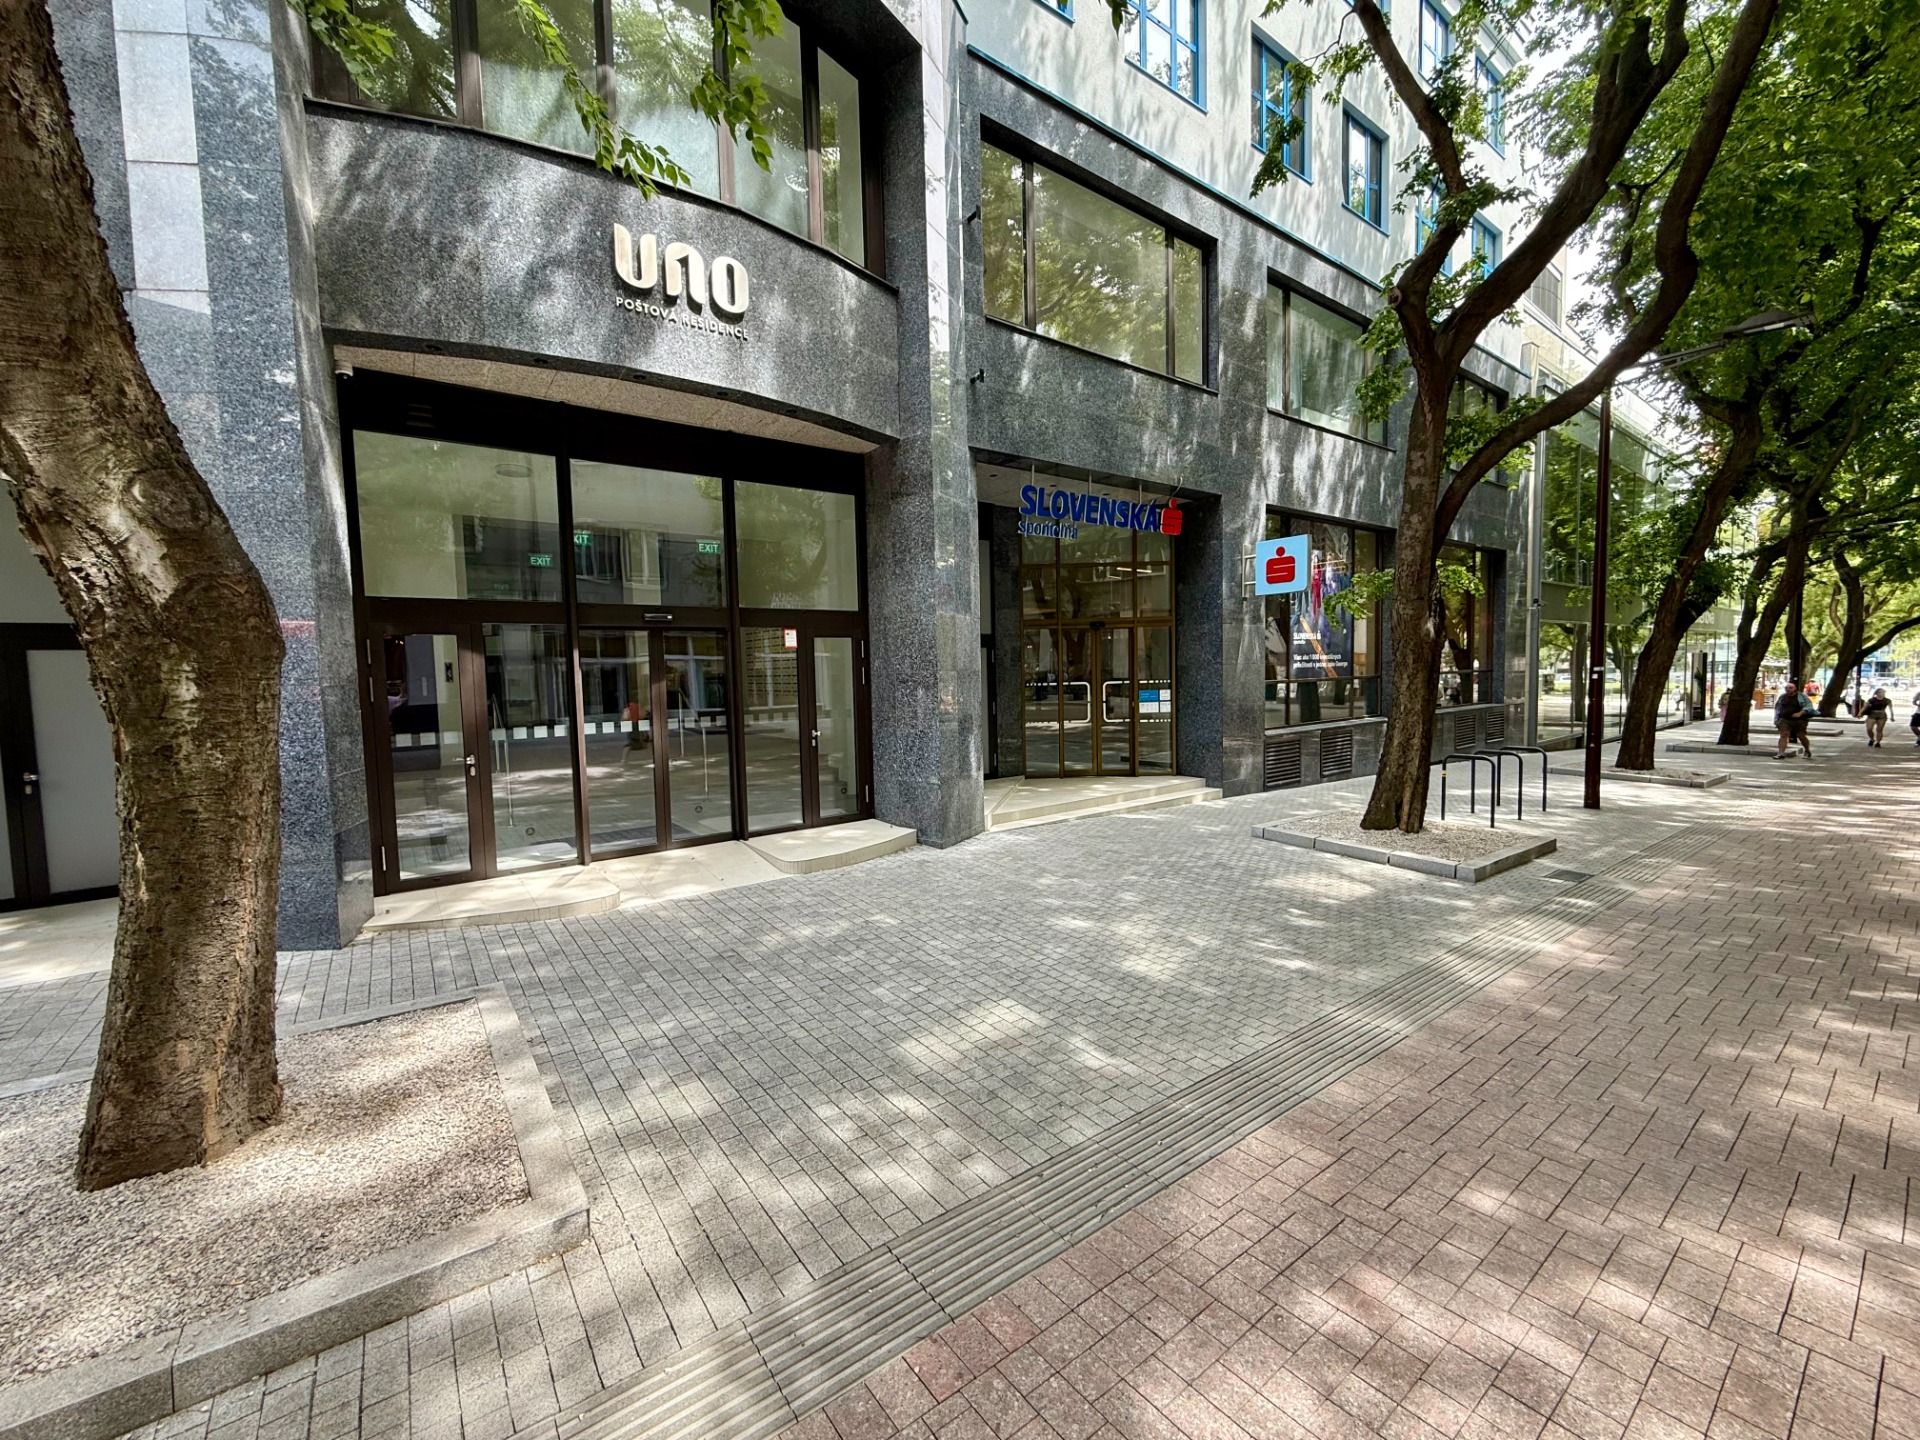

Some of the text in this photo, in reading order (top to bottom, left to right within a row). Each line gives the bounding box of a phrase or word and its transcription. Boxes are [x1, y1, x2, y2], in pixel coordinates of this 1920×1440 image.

[682, 314, 749, 340] RESIDENCE
[1019, 484, 1160, 533] SLOVENSKÁ
[574, 534, 589, 544] XIT
[698, 543, 718, 553] EXIT
[530, 557, 551, 566] EXIT
